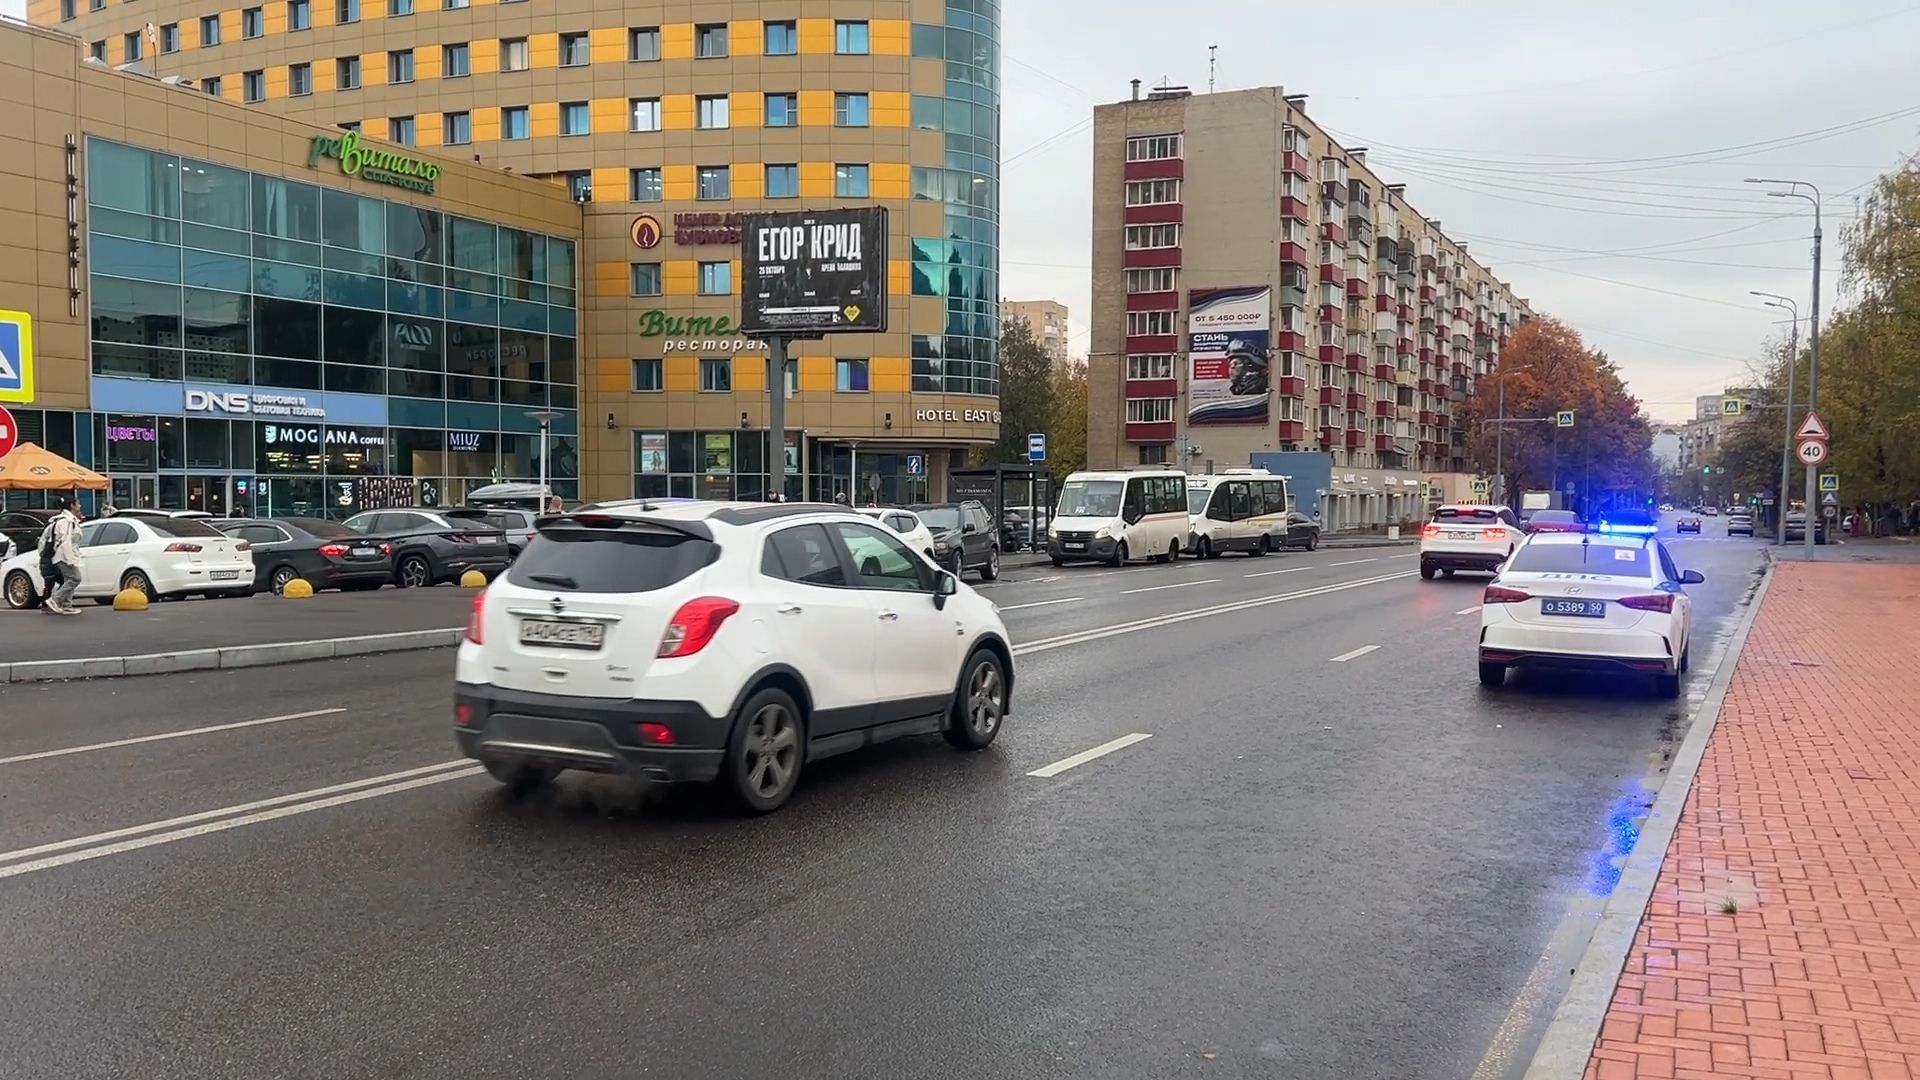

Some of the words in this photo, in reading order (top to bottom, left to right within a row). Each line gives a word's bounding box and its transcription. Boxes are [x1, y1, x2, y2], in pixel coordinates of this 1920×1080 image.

[759, 226, 804, 261] ЕГОР
[811, 223, 861, 260] КРИД
[1193, 334, 1228, 342] СТАНЬ
[663, 339, 768, 353] ресторан
[185, 390, 249, 413] DNS
[916, 409, 959, 421] HOTEL
[964, 409, 991, 422] EAST
[449, 432, 480, 446] MIUZ
[1803, 446, 1820, 457] 40
[1538, 573, 1612, 581] ДПС
[1557, 601, 1585, 612] 5389
[1591, 603, 1602, 612] 50
